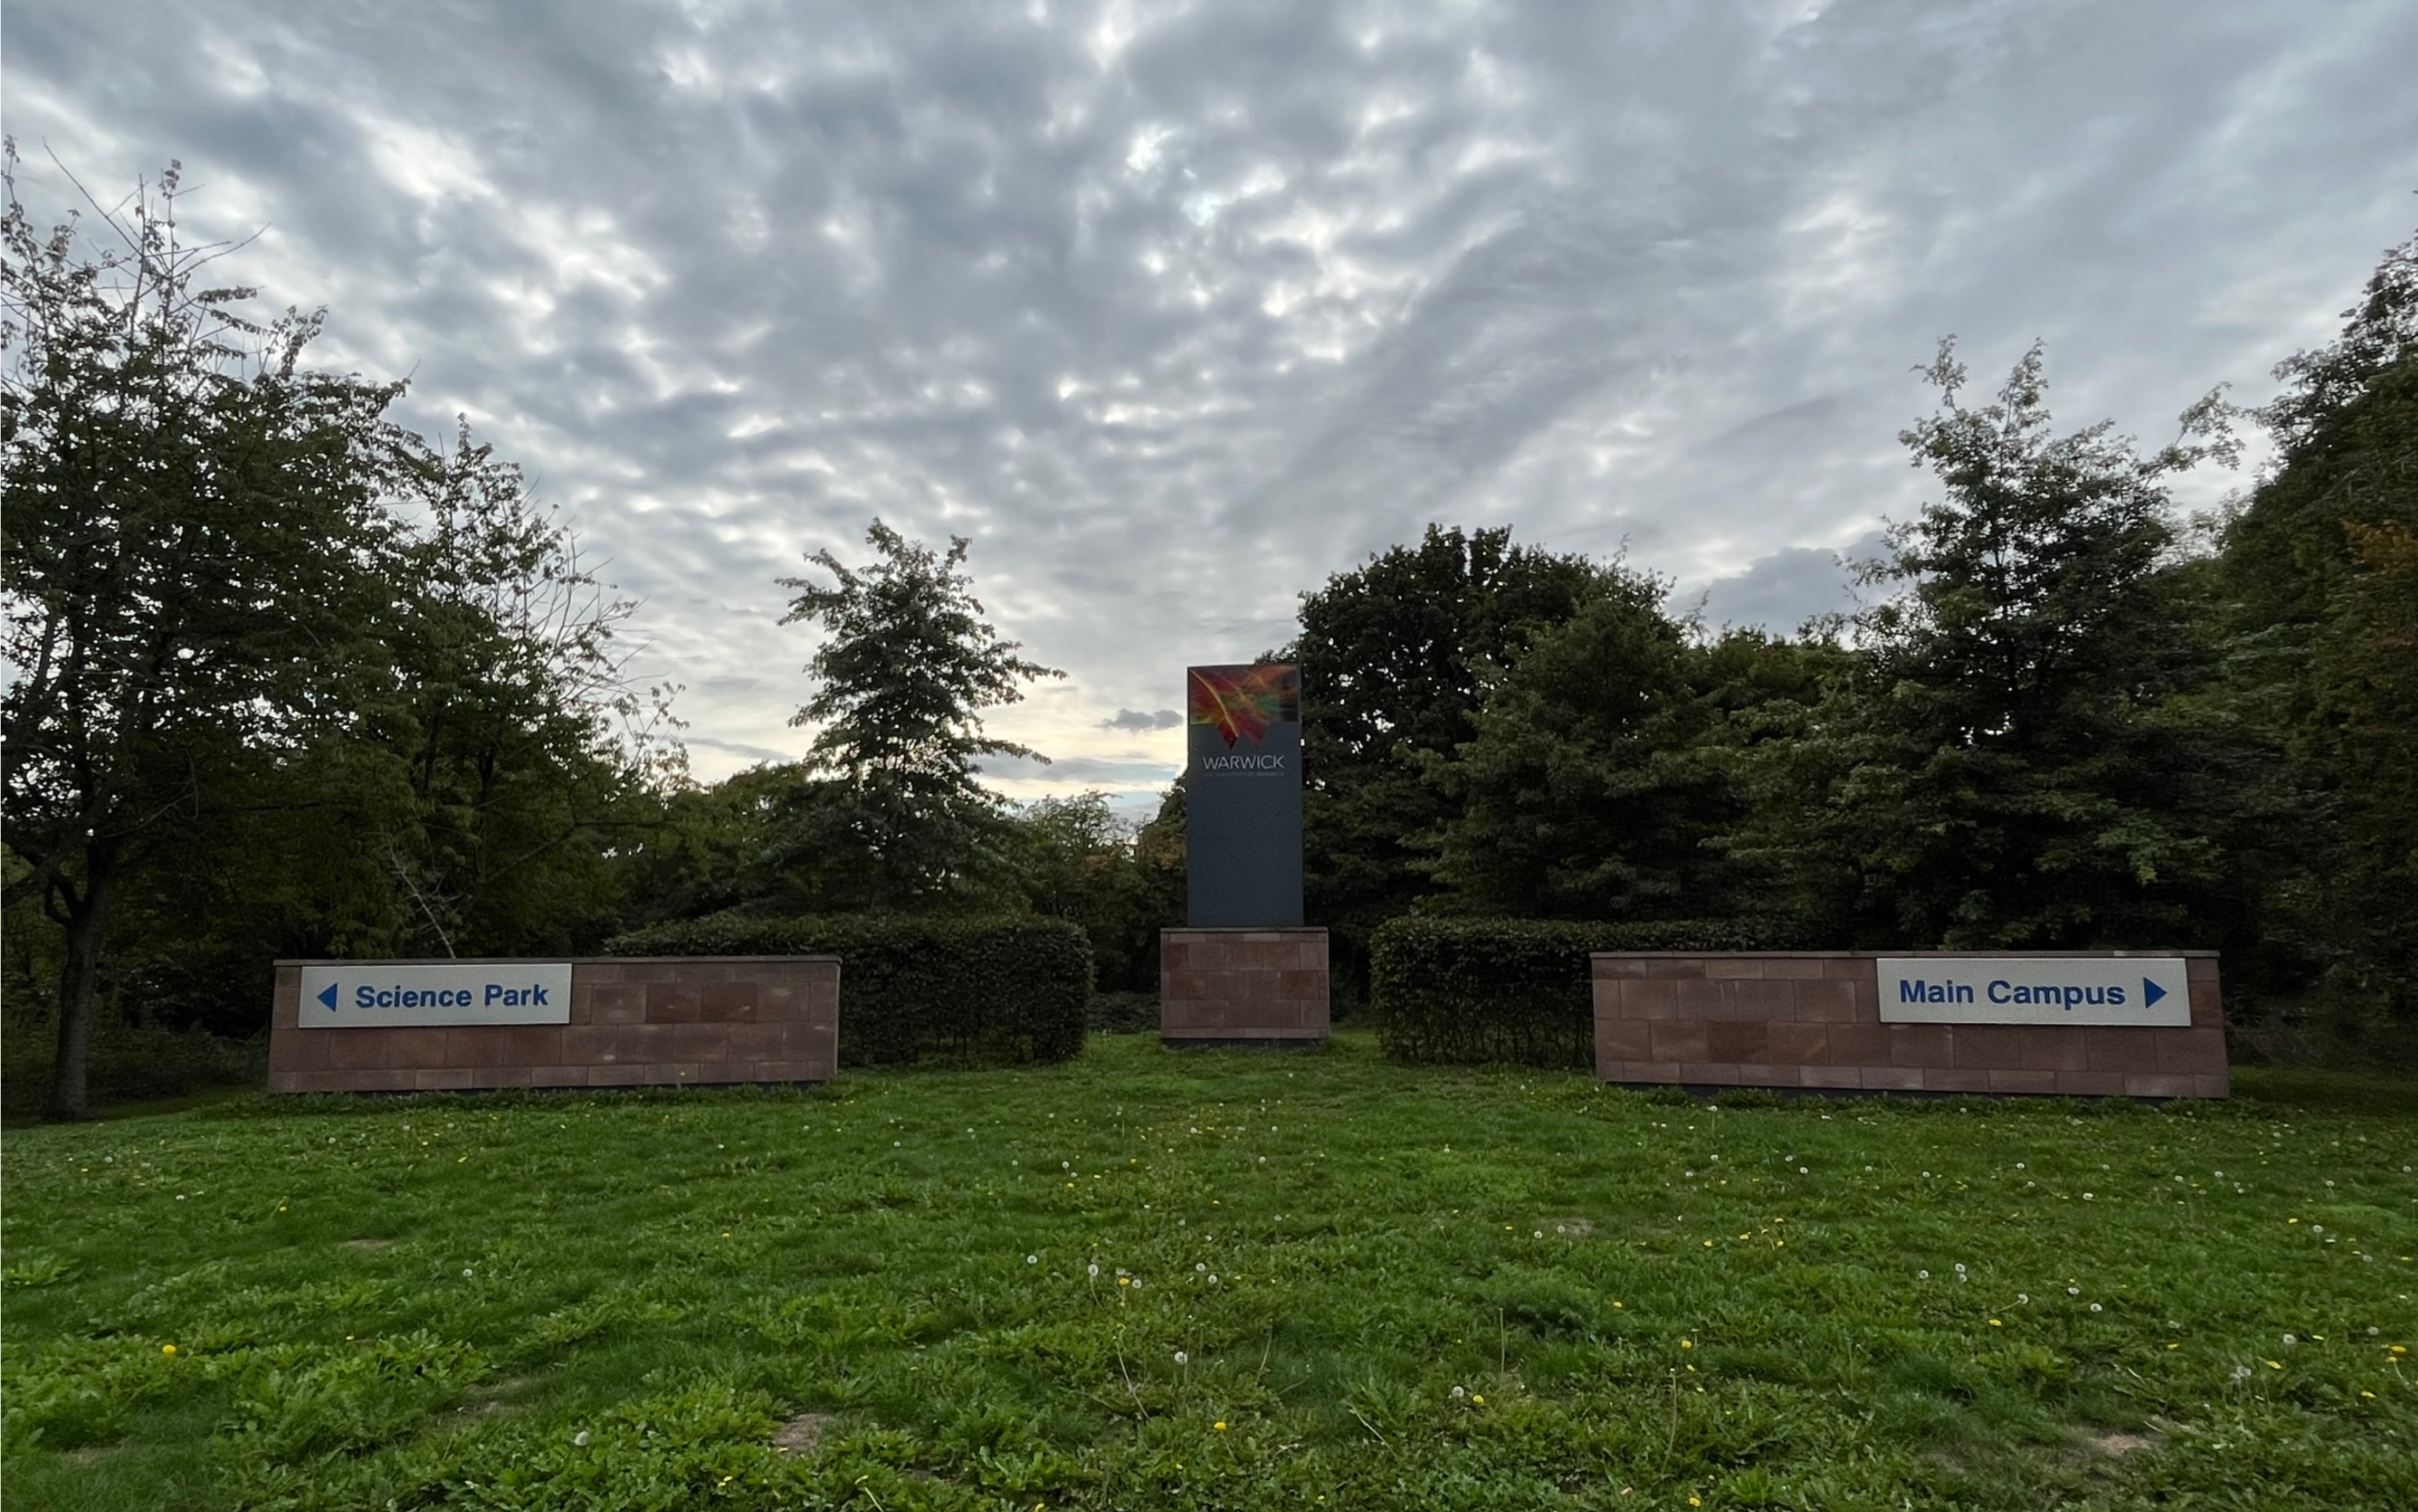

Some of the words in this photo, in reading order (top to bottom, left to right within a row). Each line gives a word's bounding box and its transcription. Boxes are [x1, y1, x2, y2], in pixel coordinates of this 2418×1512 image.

[1202, 754, 1285, 770] WARWICK
[355, 985, 472, 1008] Science
[485, 984, 549, 1007] Park
[1900, 979, 1974, 1004] Main
[1987, 980, 2126, 1011] Campus
